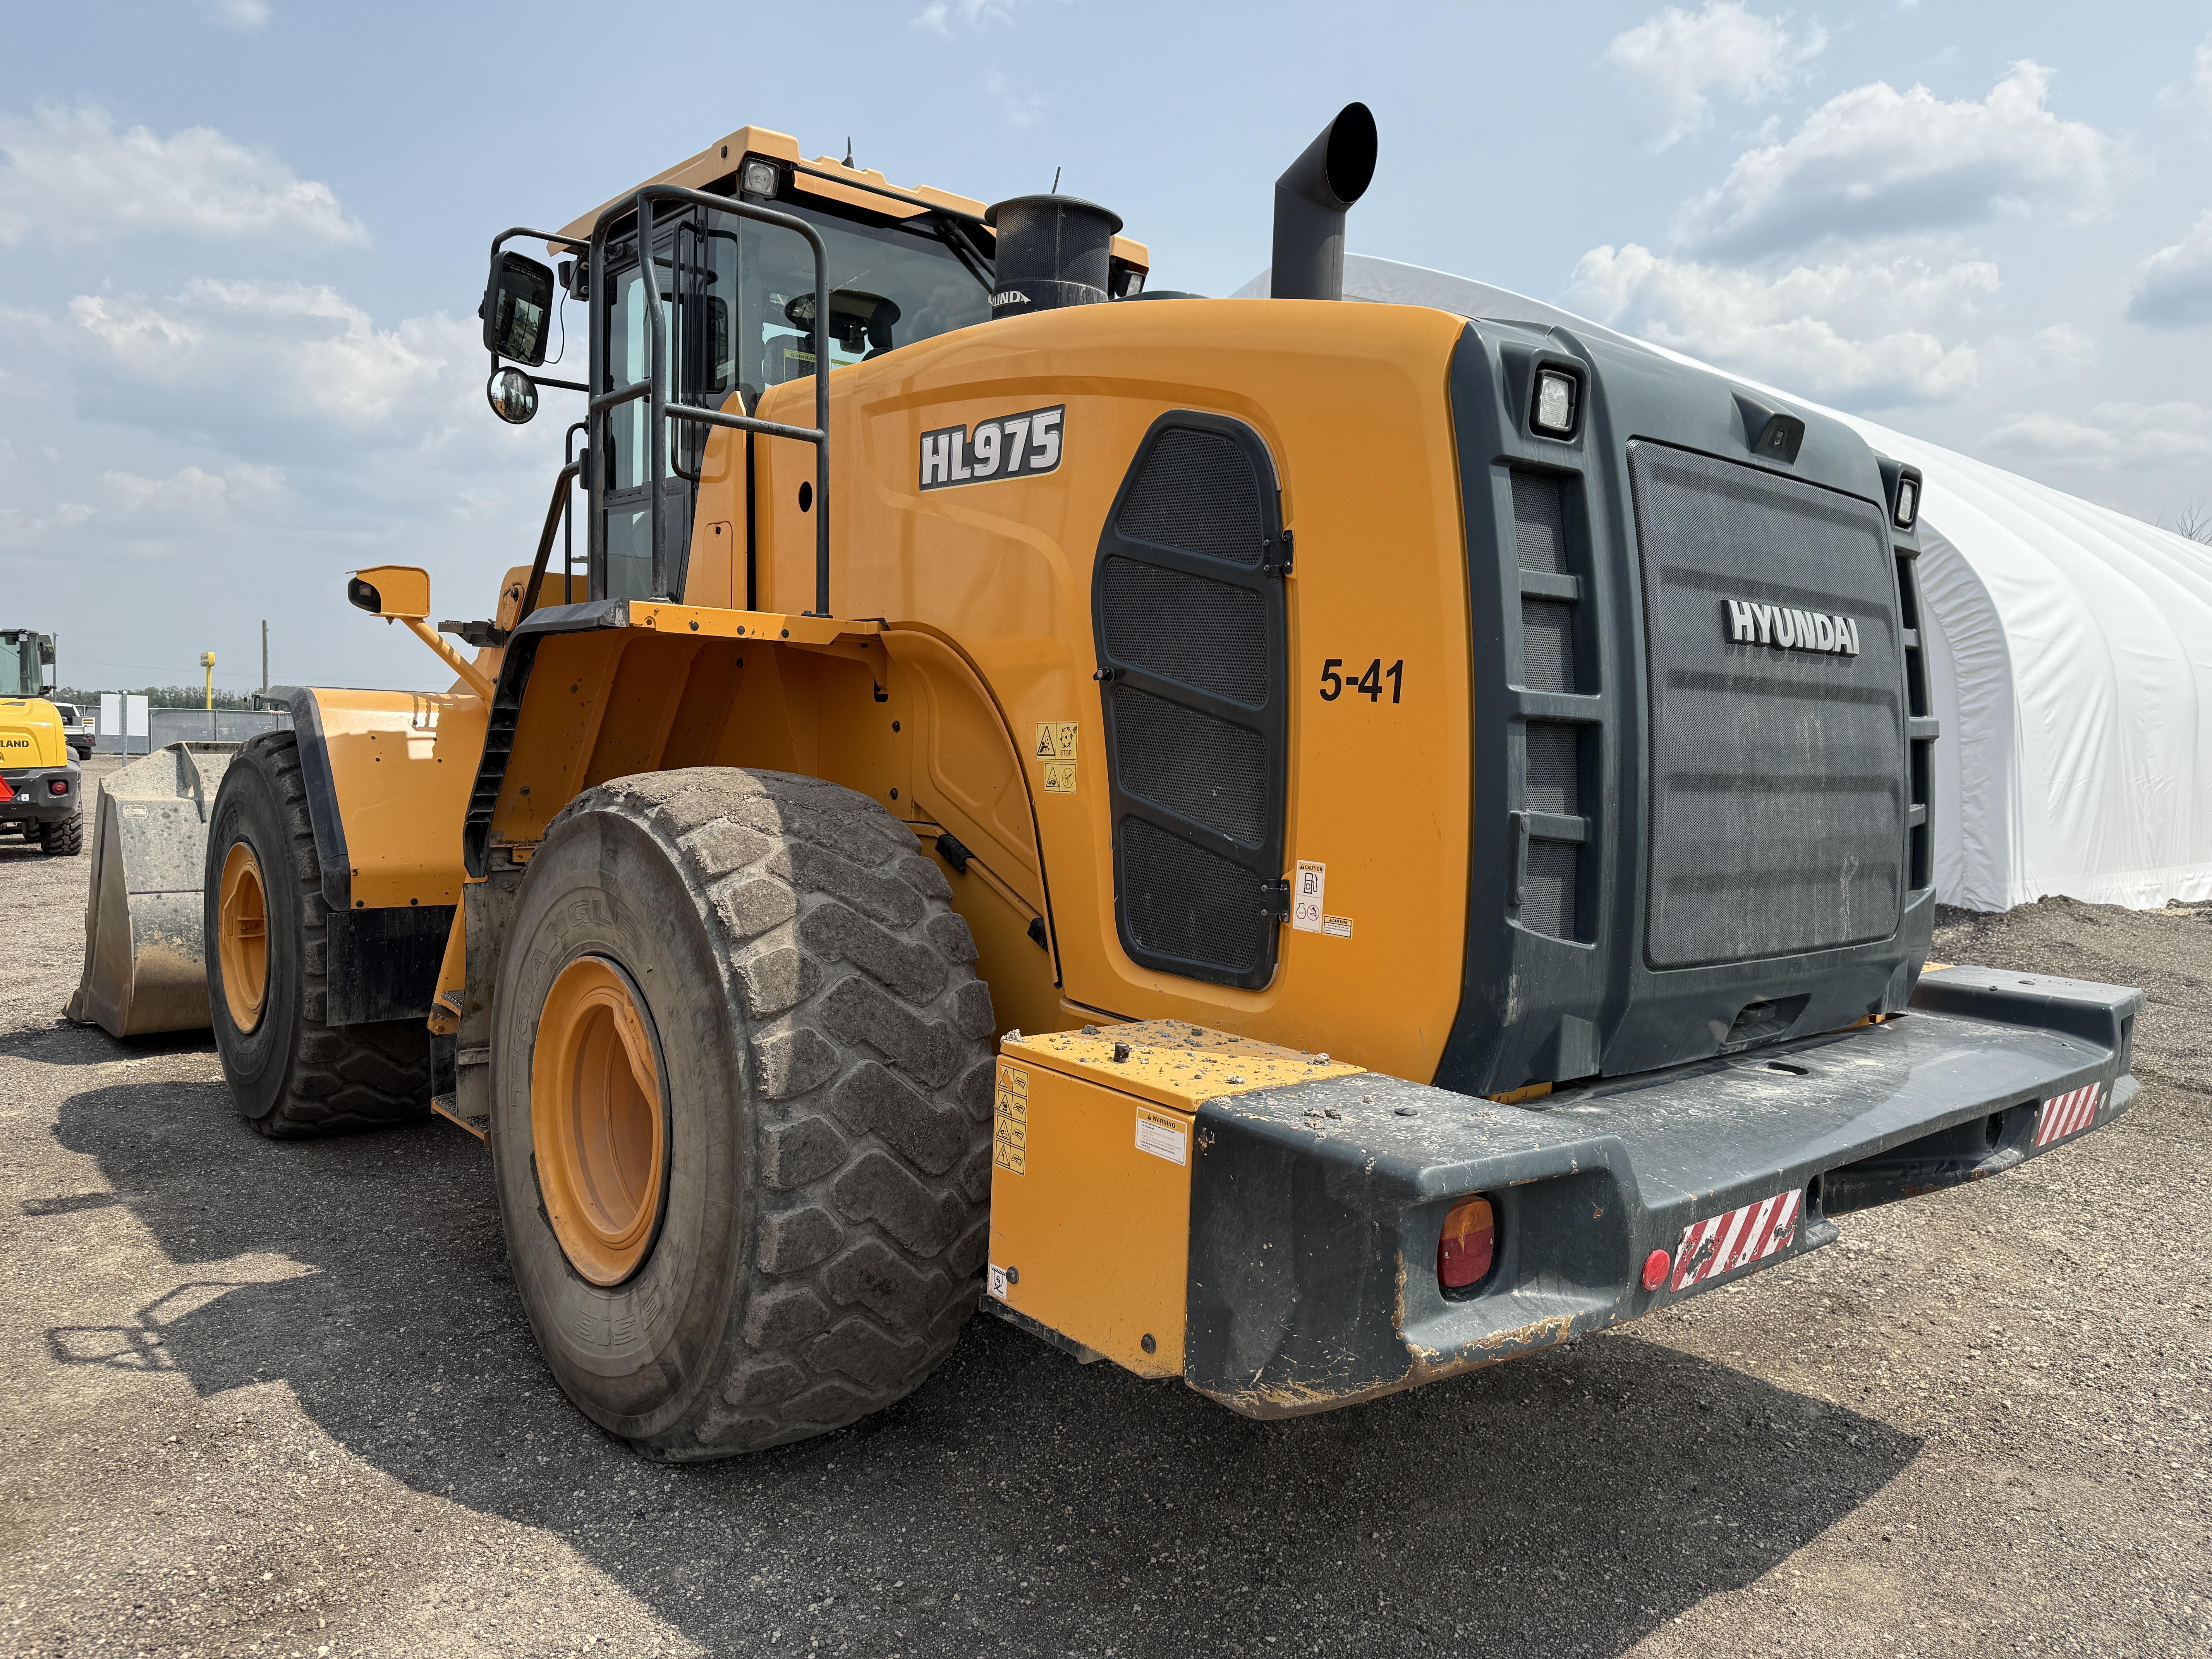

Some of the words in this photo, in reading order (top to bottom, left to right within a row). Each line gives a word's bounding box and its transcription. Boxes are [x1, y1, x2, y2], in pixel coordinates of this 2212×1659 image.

[922, 409, 1063, 484] HL975
[1724, 599, 1860, 657] HYUNDAI
[1320, 659, 1403, 704] 5-41
[1153, 1116, 1175, 1128] WARNING
